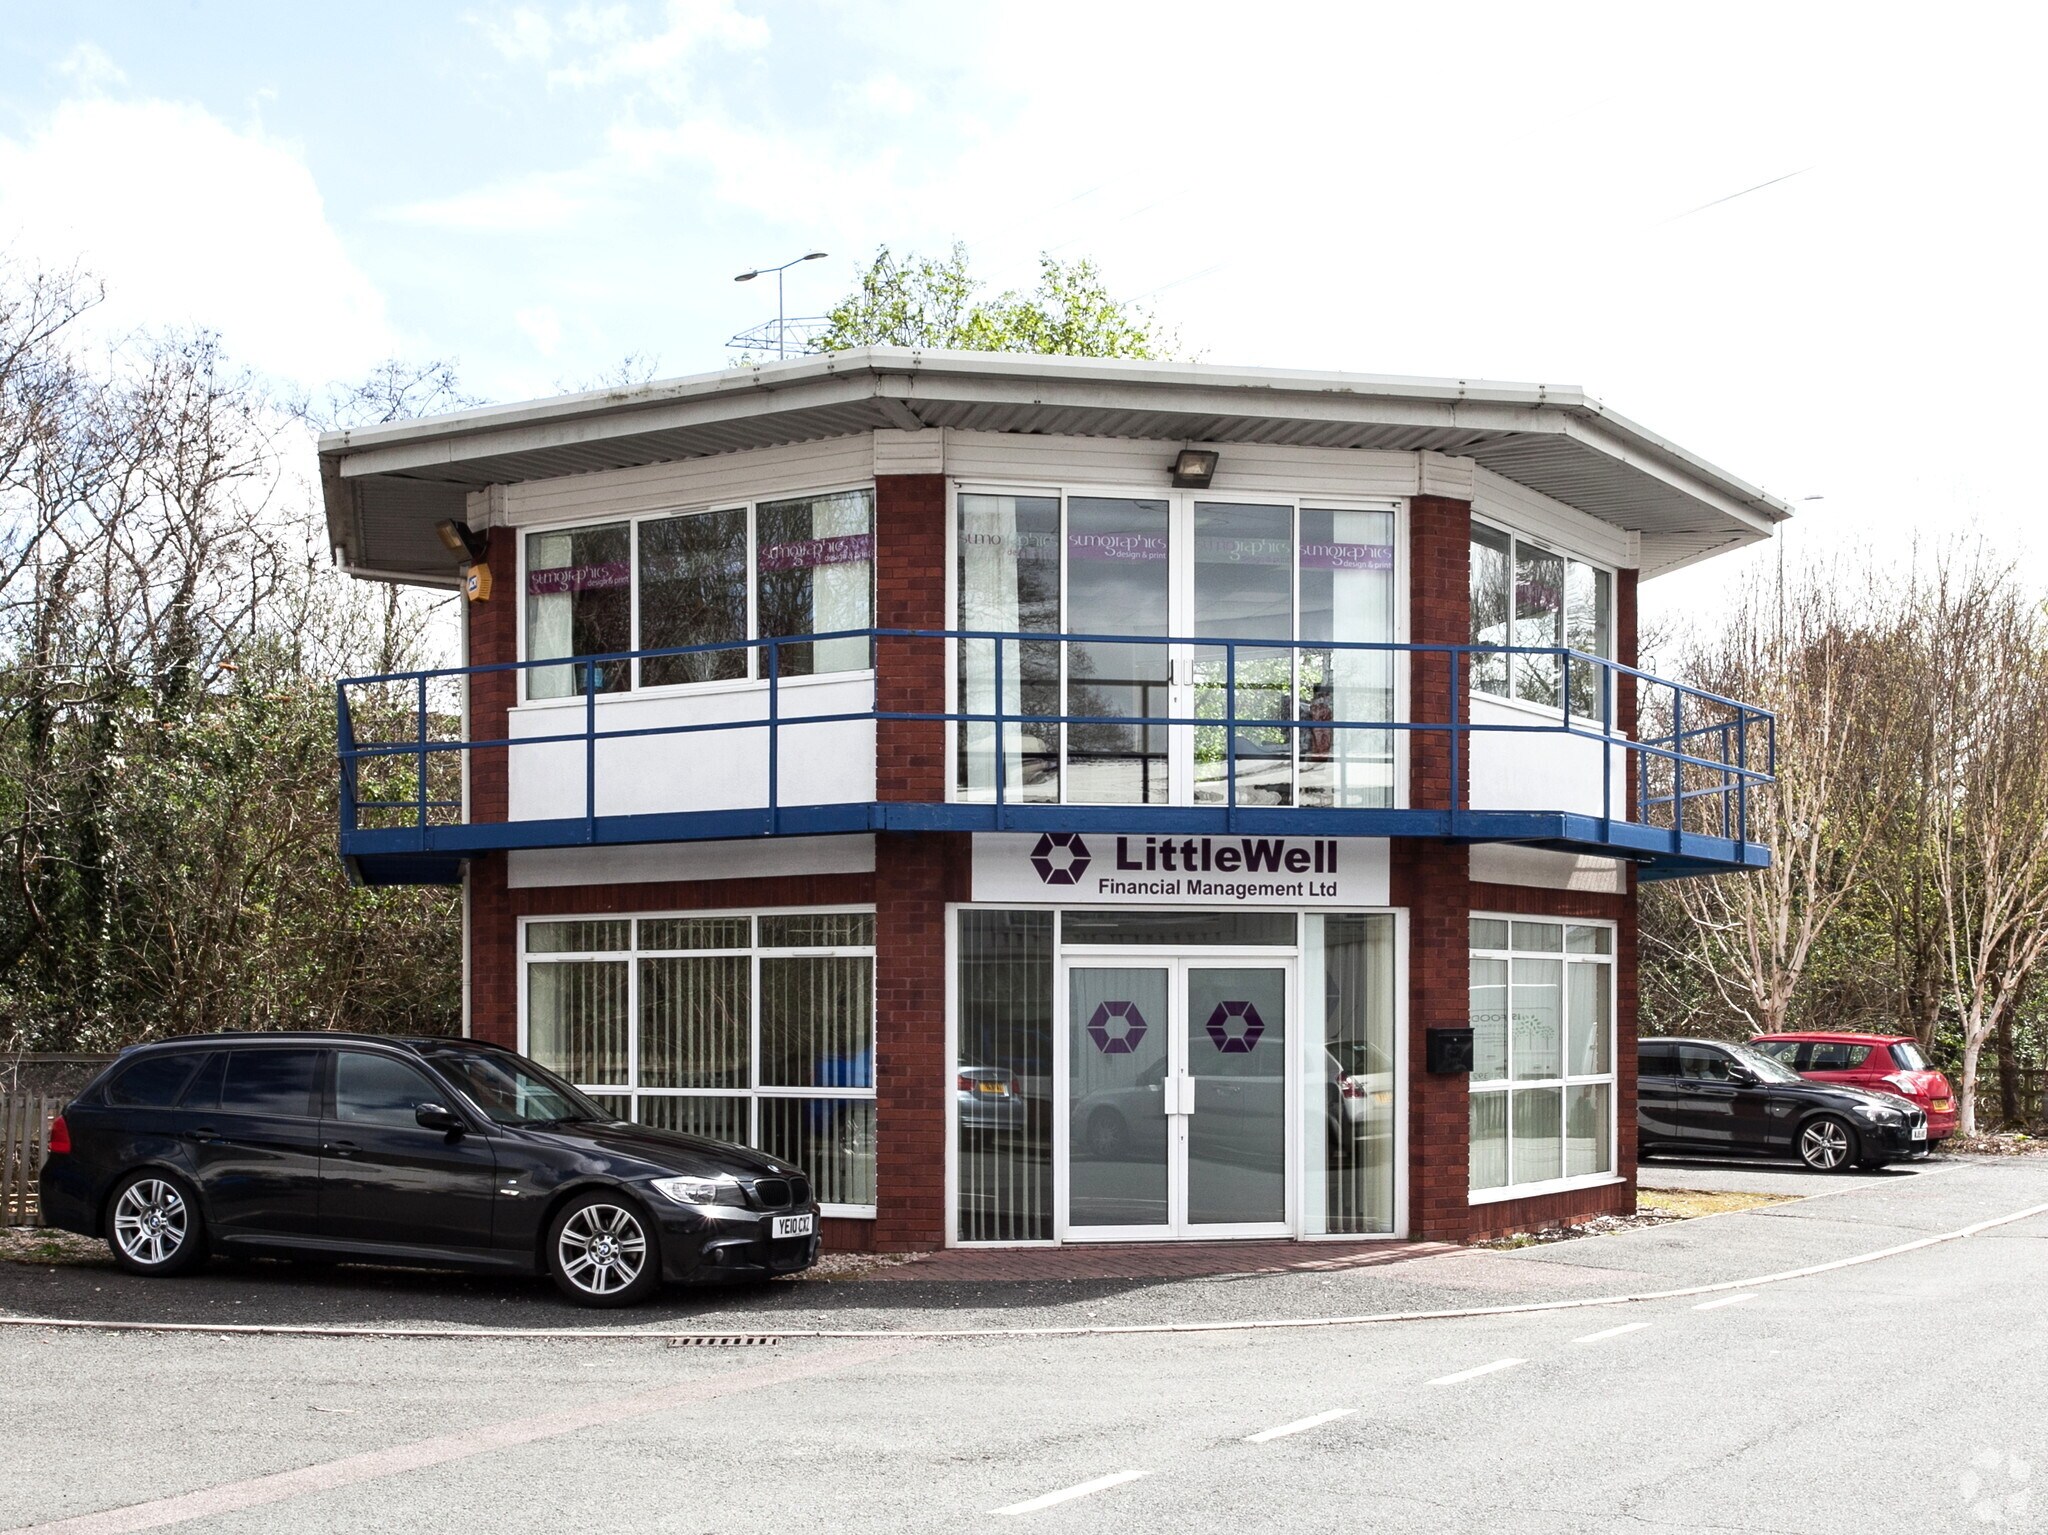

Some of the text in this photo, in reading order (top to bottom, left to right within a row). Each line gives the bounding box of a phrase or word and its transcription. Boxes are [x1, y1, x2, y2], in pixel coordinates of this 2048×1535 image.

[1069, 535, 1167, 557] sumographics
[1116, 550, 1141, 560] design
[1149, 552, 1167, 560] print
[1299, 544, 1392, 566] sumographics
[1343, 560, 1367, 569] design
[1374, 562, 1392, 570] print
[1117, 837, 1337, 873] LittleWell
[1099, 878, 1337, 899] Financial Management Ltd
[779, 1219, 798, 1235] YE10
